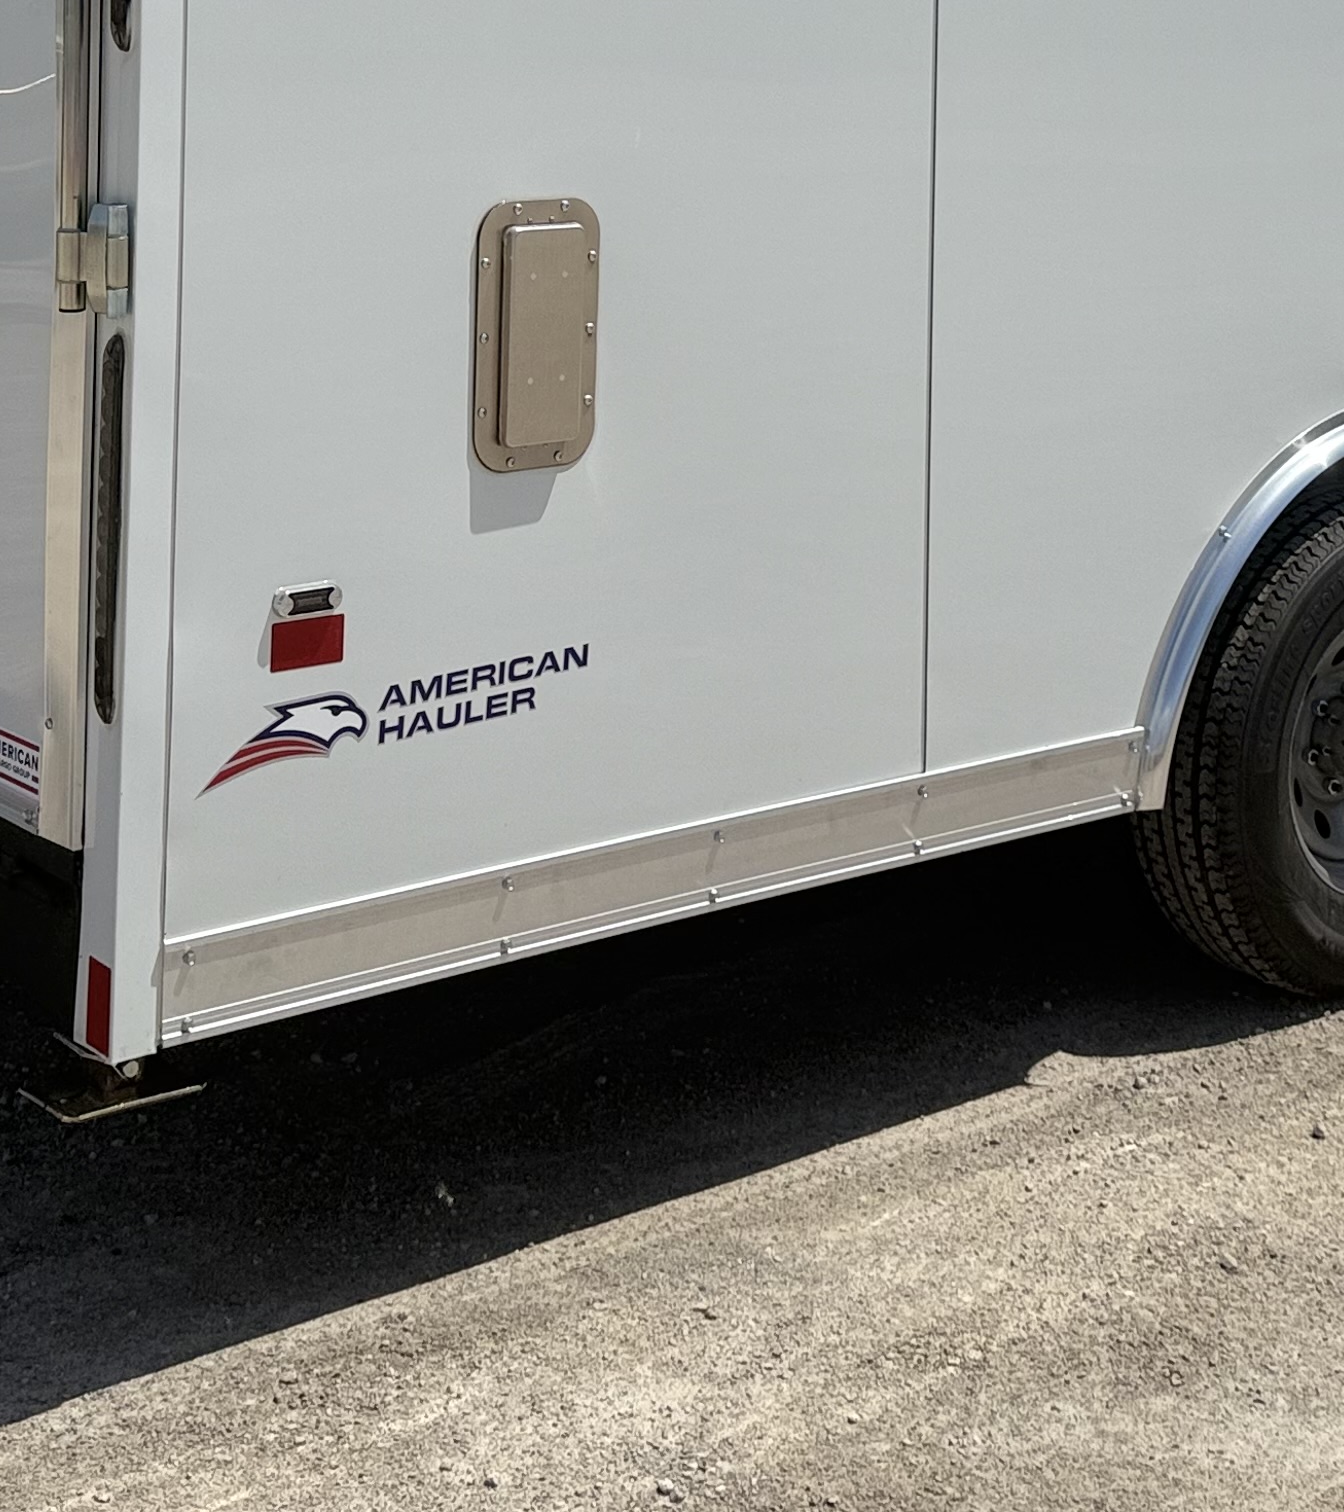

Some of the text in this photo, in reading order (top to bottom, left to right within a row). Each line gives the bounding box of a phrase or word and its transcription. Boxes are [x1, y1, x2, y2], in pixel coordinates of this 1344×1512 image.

[377, 642, 591, 712] AMERICAN
[376, 686, 537, 746] HAULER
[12, 765, 31, 780] GROUP
